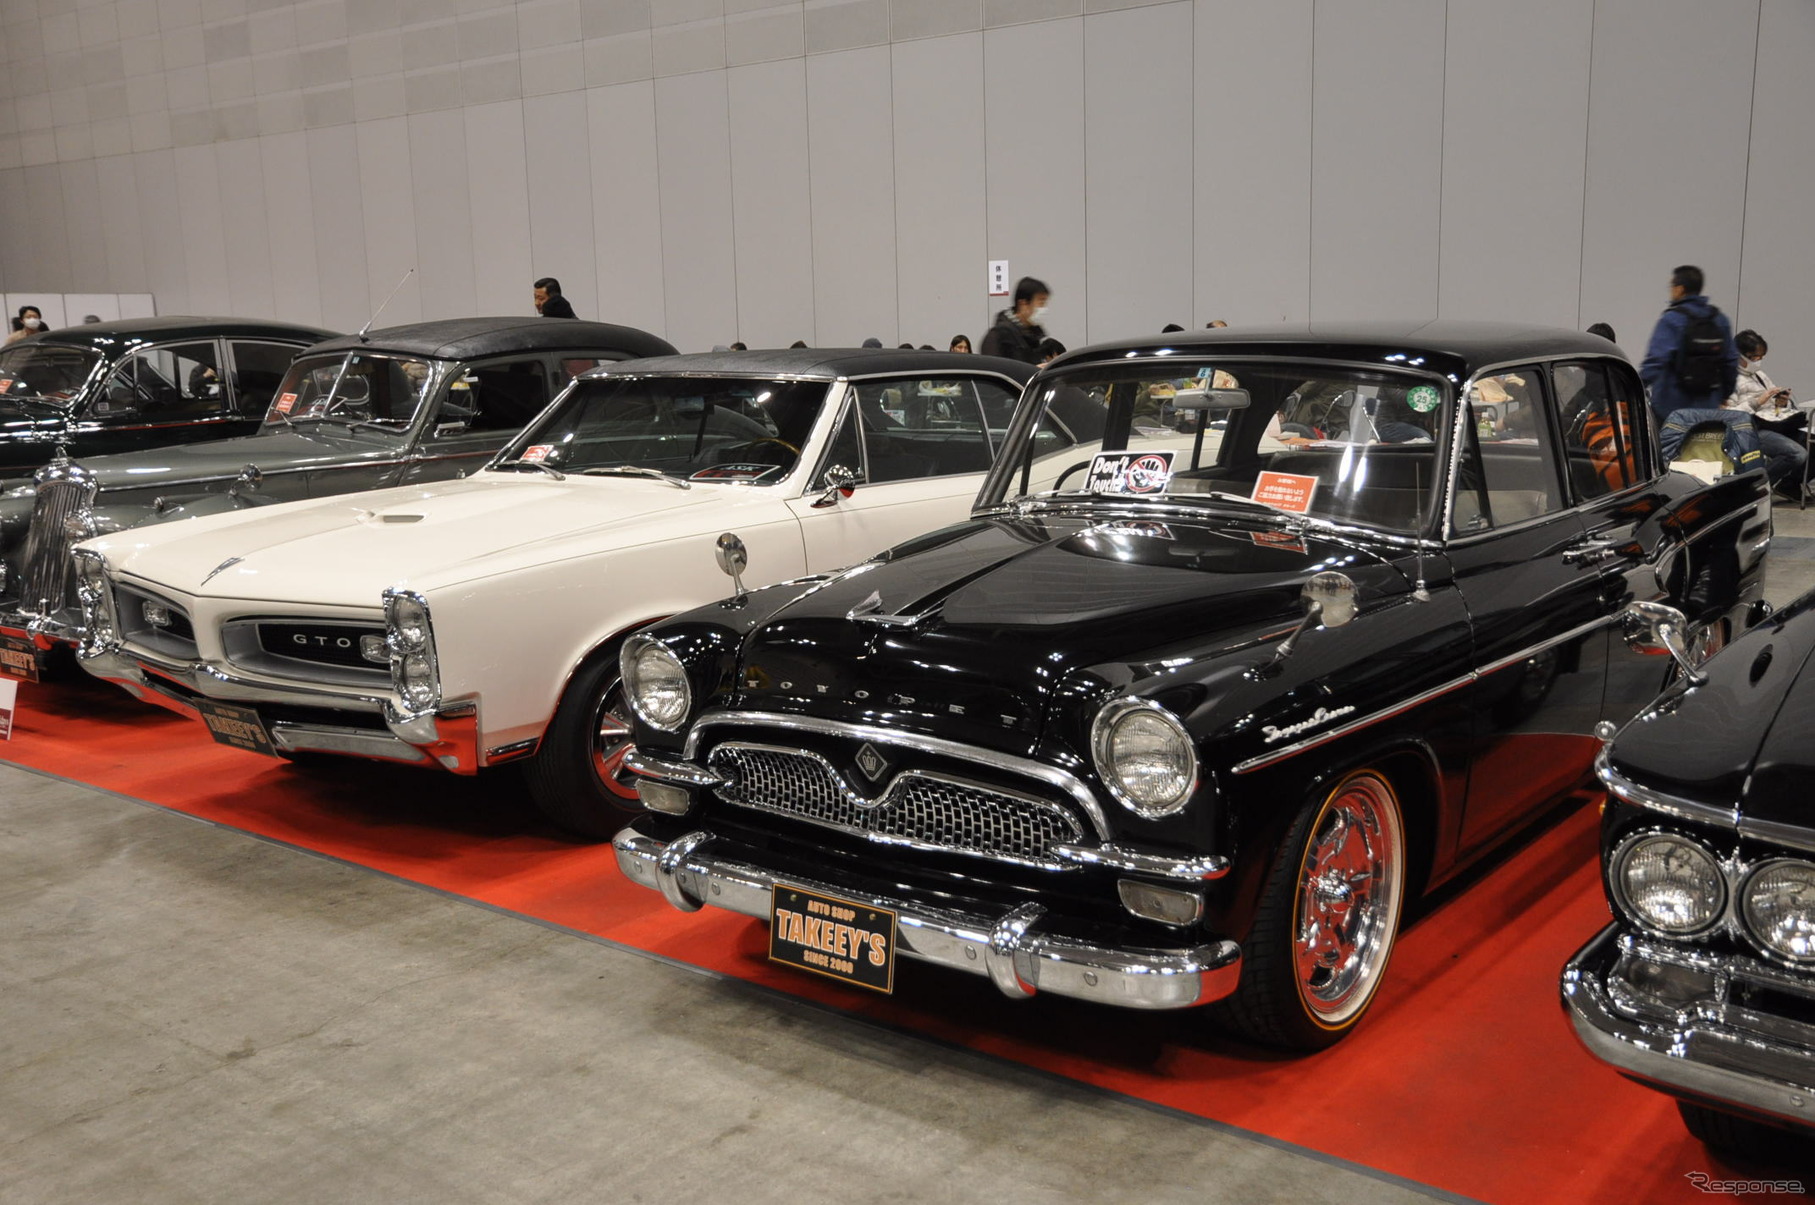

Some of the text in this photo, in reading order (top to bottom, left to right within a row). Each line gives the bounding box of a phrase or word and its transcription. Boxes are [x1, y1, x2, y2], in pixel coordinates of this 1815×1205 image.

[1093, 456, 1130, 475] Don't
[293, 634, 351, 648] GTO
[747, 680, 1018, 725] TOYOPET
[807, 899, 856, 922] AUTO SHOP
[776, 907, 886, 966] TAKEEY'S
[803, 949, 829, 967] SINCE
